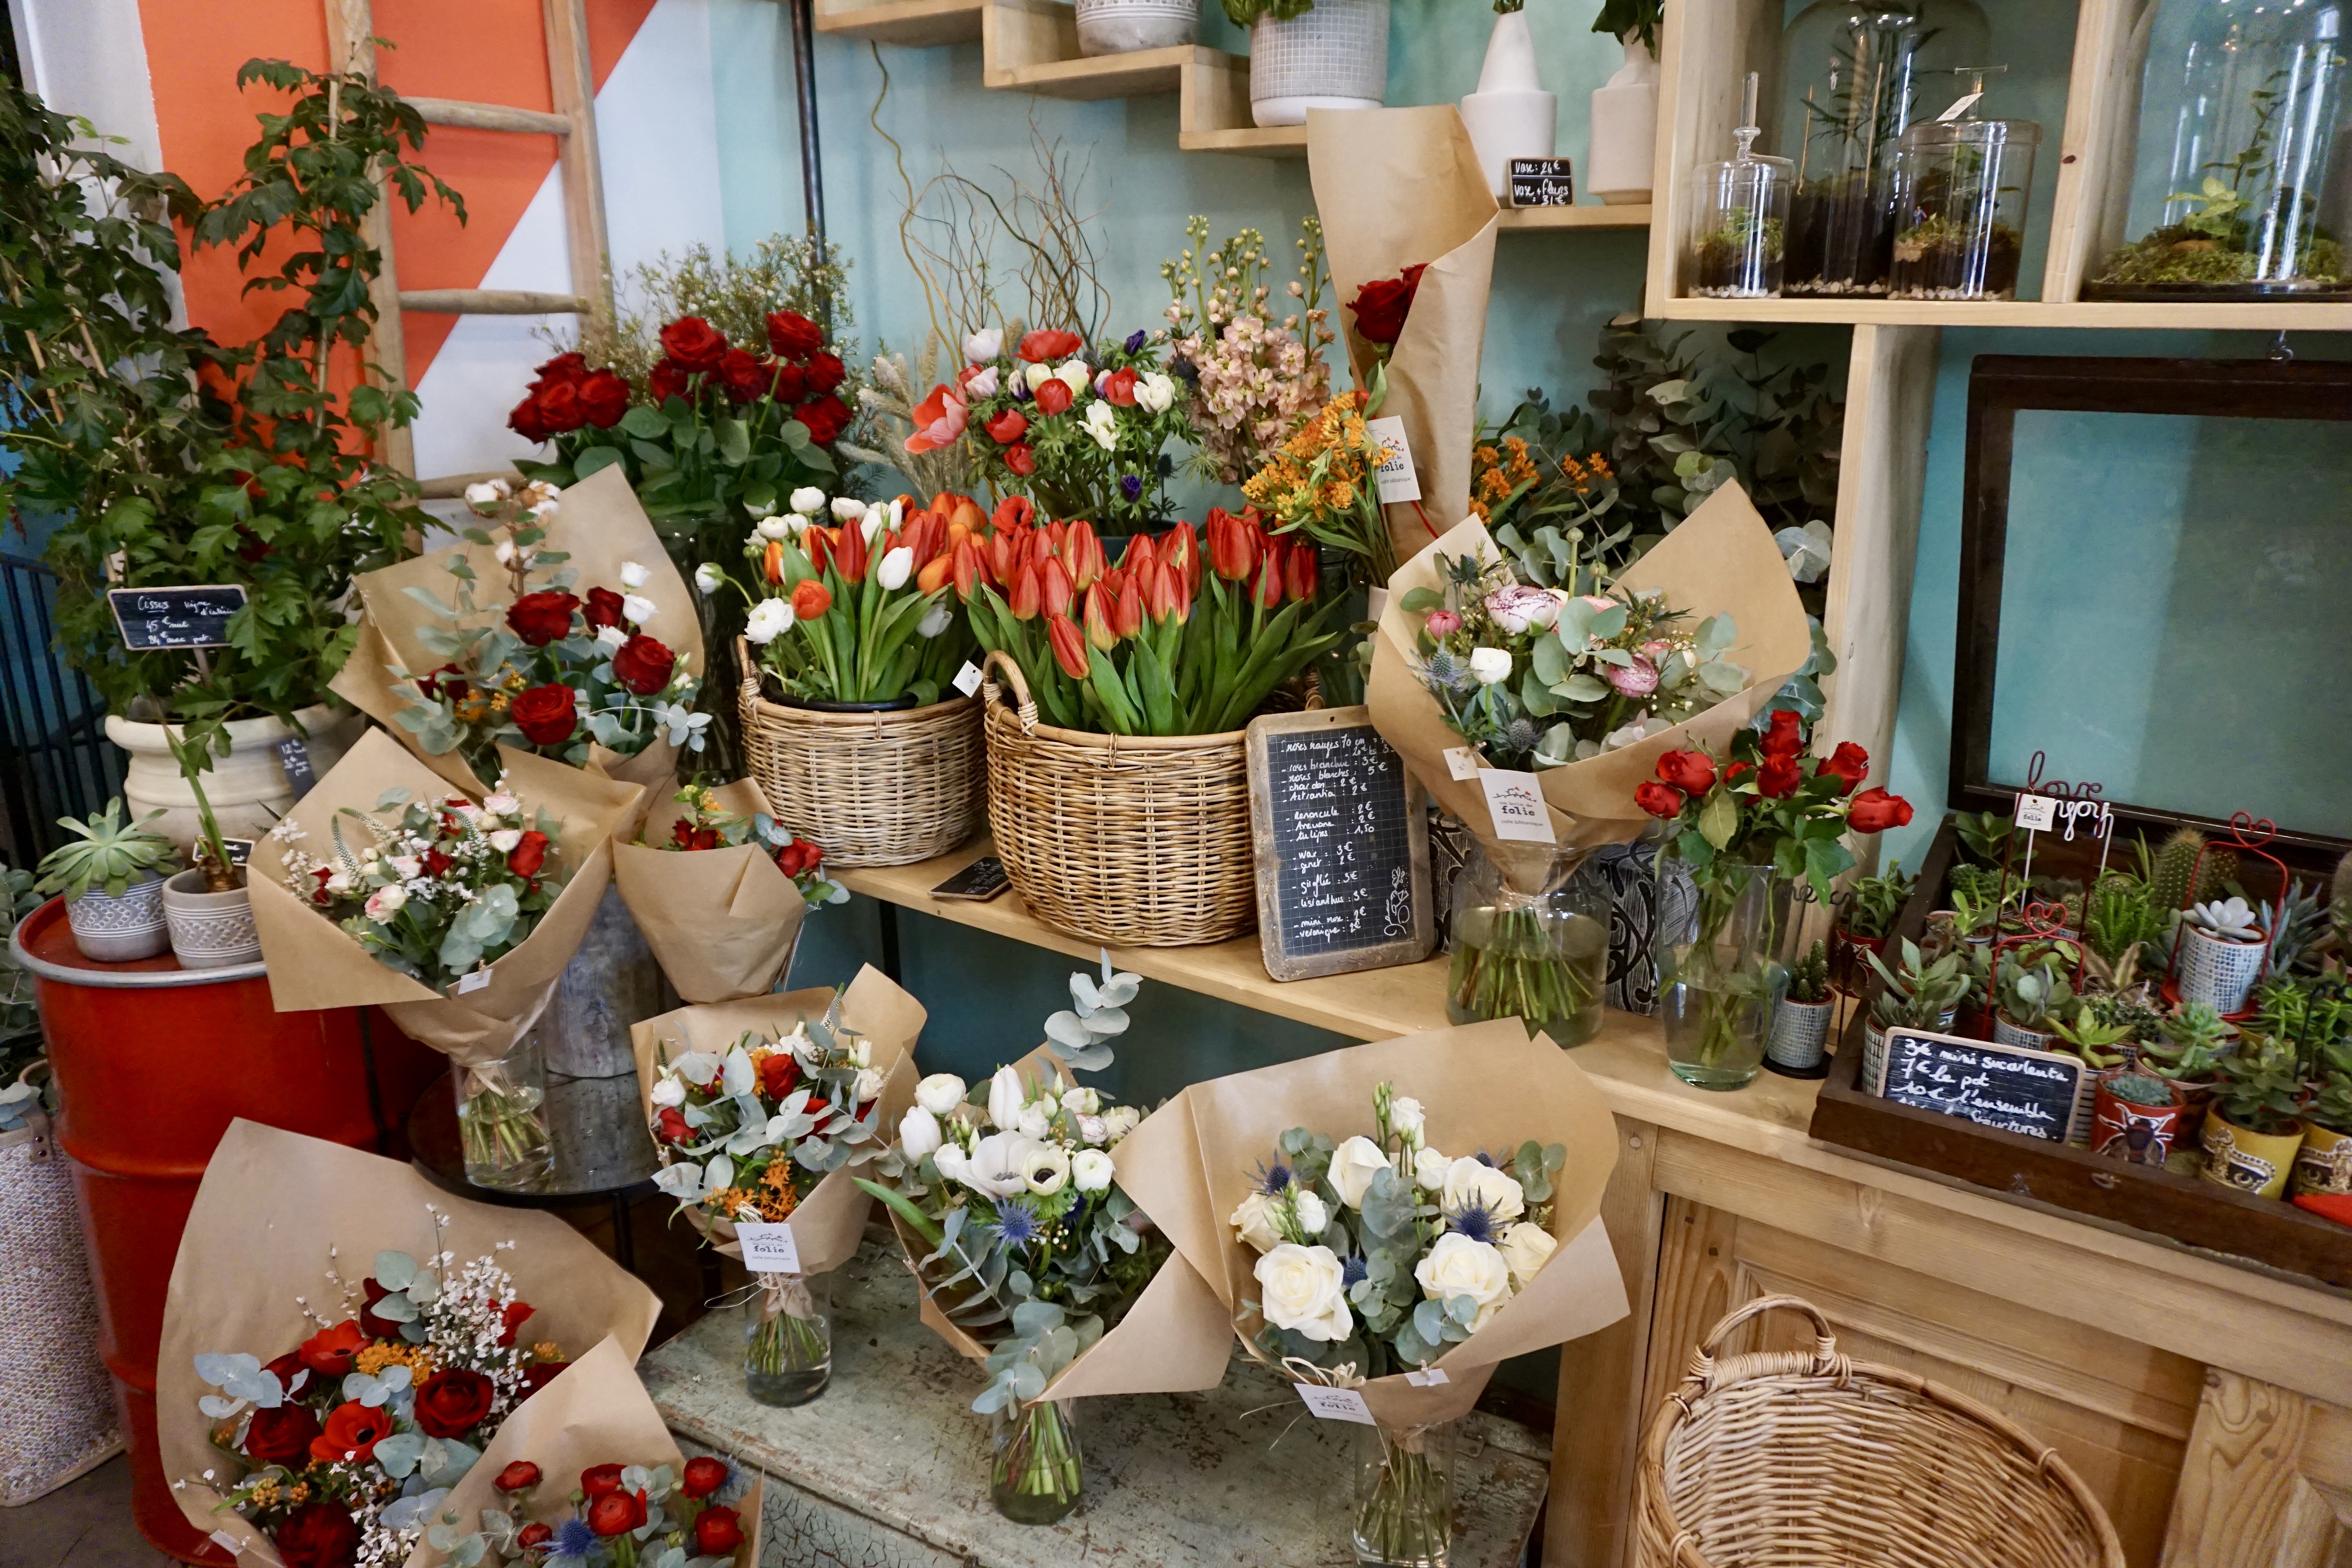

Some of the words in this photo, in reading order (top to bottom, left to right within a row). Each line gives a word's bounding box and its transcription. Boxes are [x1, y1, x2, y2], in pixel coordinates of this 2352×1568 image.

[1286, 742, 1307, 752] roses
[1341, 733, 1352, 749] 70
[1289, 763, 1307, 772] roses
[1289, 772, 1311, 782] roses
[1318, 768, 1349, 780] blanches
[1501, 805, 1535, 816] folie
[1301, 893, 1345, 908] lisianthus
[1301, 915, 1321, 928] mini
[1938, 1049, 1977, 1065] mini
[1960, 1072, 1990, 1090] pot
[1320, 1402, 1356, 1411] folie
